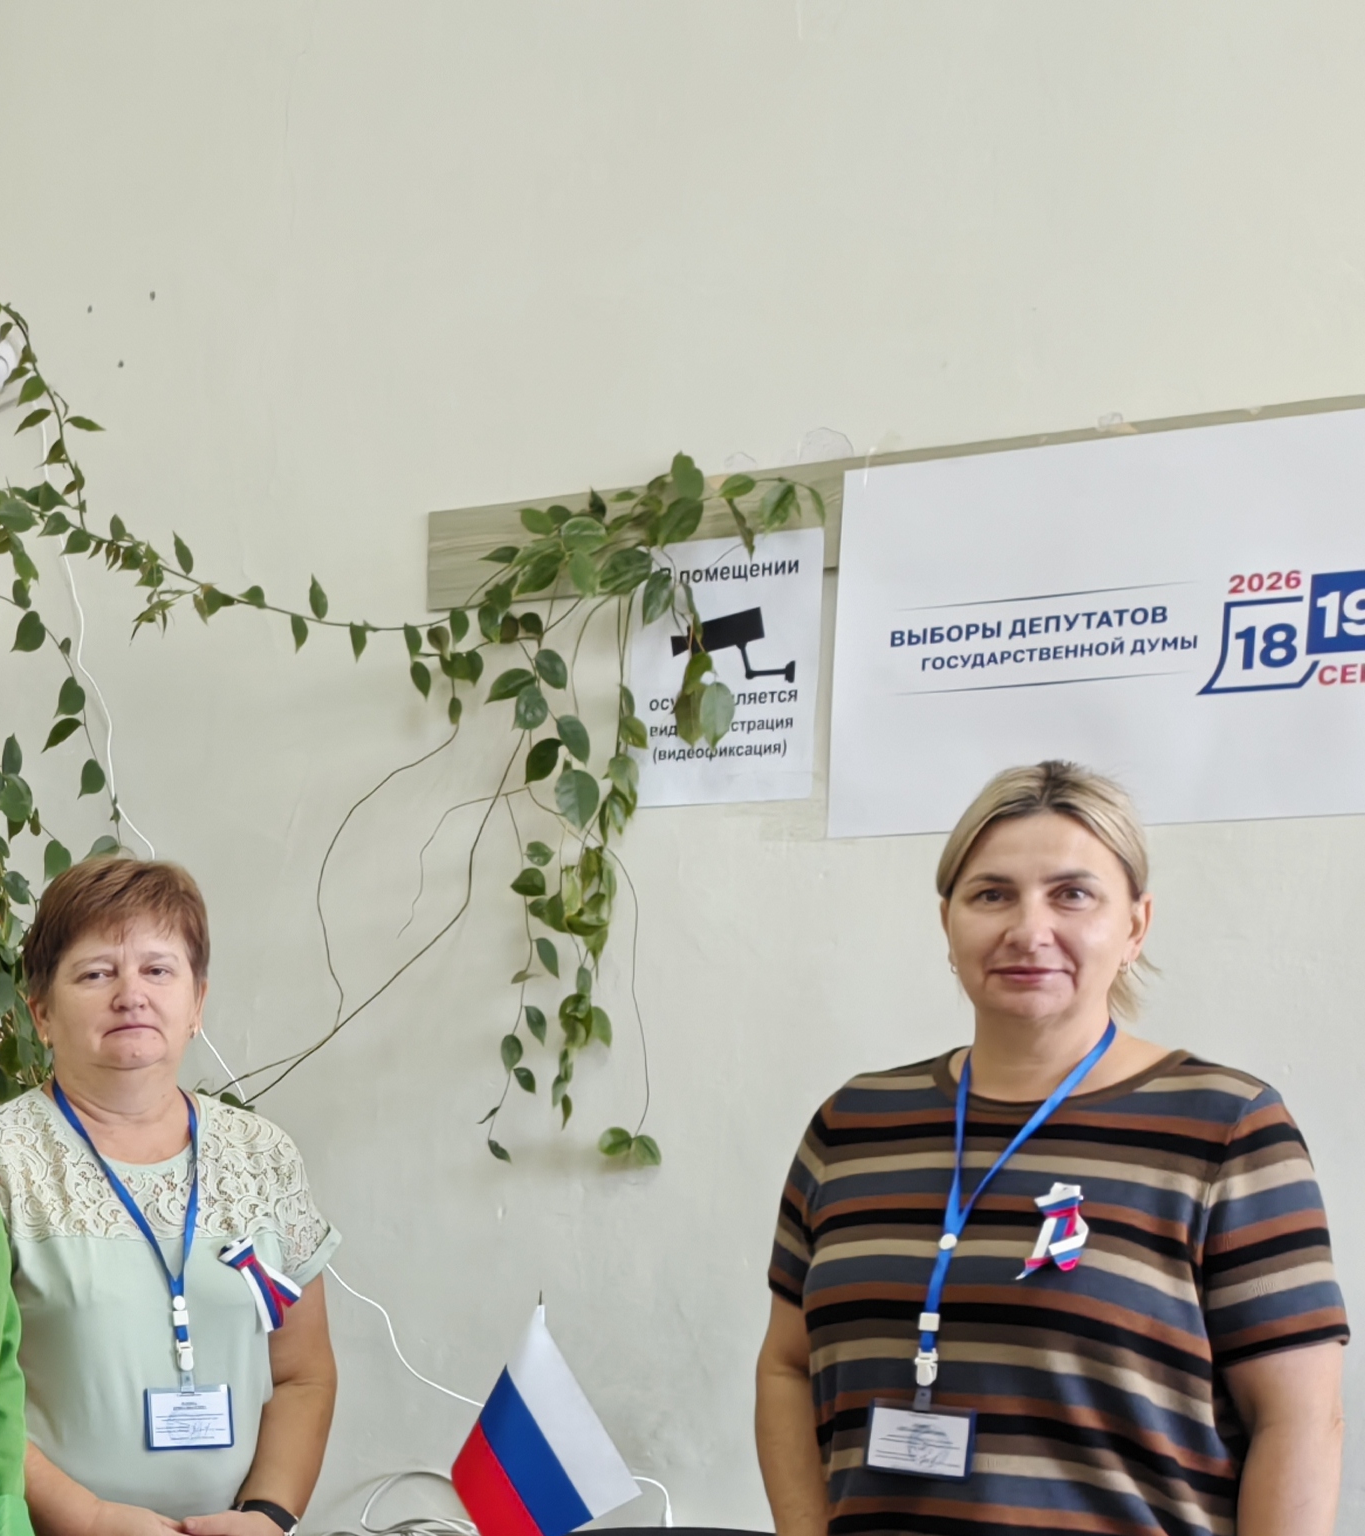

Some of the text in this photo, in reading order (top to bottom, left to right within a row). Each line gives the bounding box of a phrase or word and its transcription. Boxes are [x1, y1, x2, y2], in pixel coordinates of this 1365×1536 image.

[679, 559, 800, 584] помещении
[1228, 570, 1302, 594] 2026
[1316, 588, 1365, 638] 19
[889, 605, 1169, 647] ВЫБОРЫ ДЕПУТАТОВ
[921, 635, 1199, 671] ГОСУДАРСТВЕННОЙ ДУМЫ
[1235, 623, 1298, 670] 18
[1317, 663, 1365, 686] СЕ
[649, 689, 798, 714] осуляется
[649, 717, 794, 737] видстрация
[652, 739, 788, 764] (видеофиксация)
